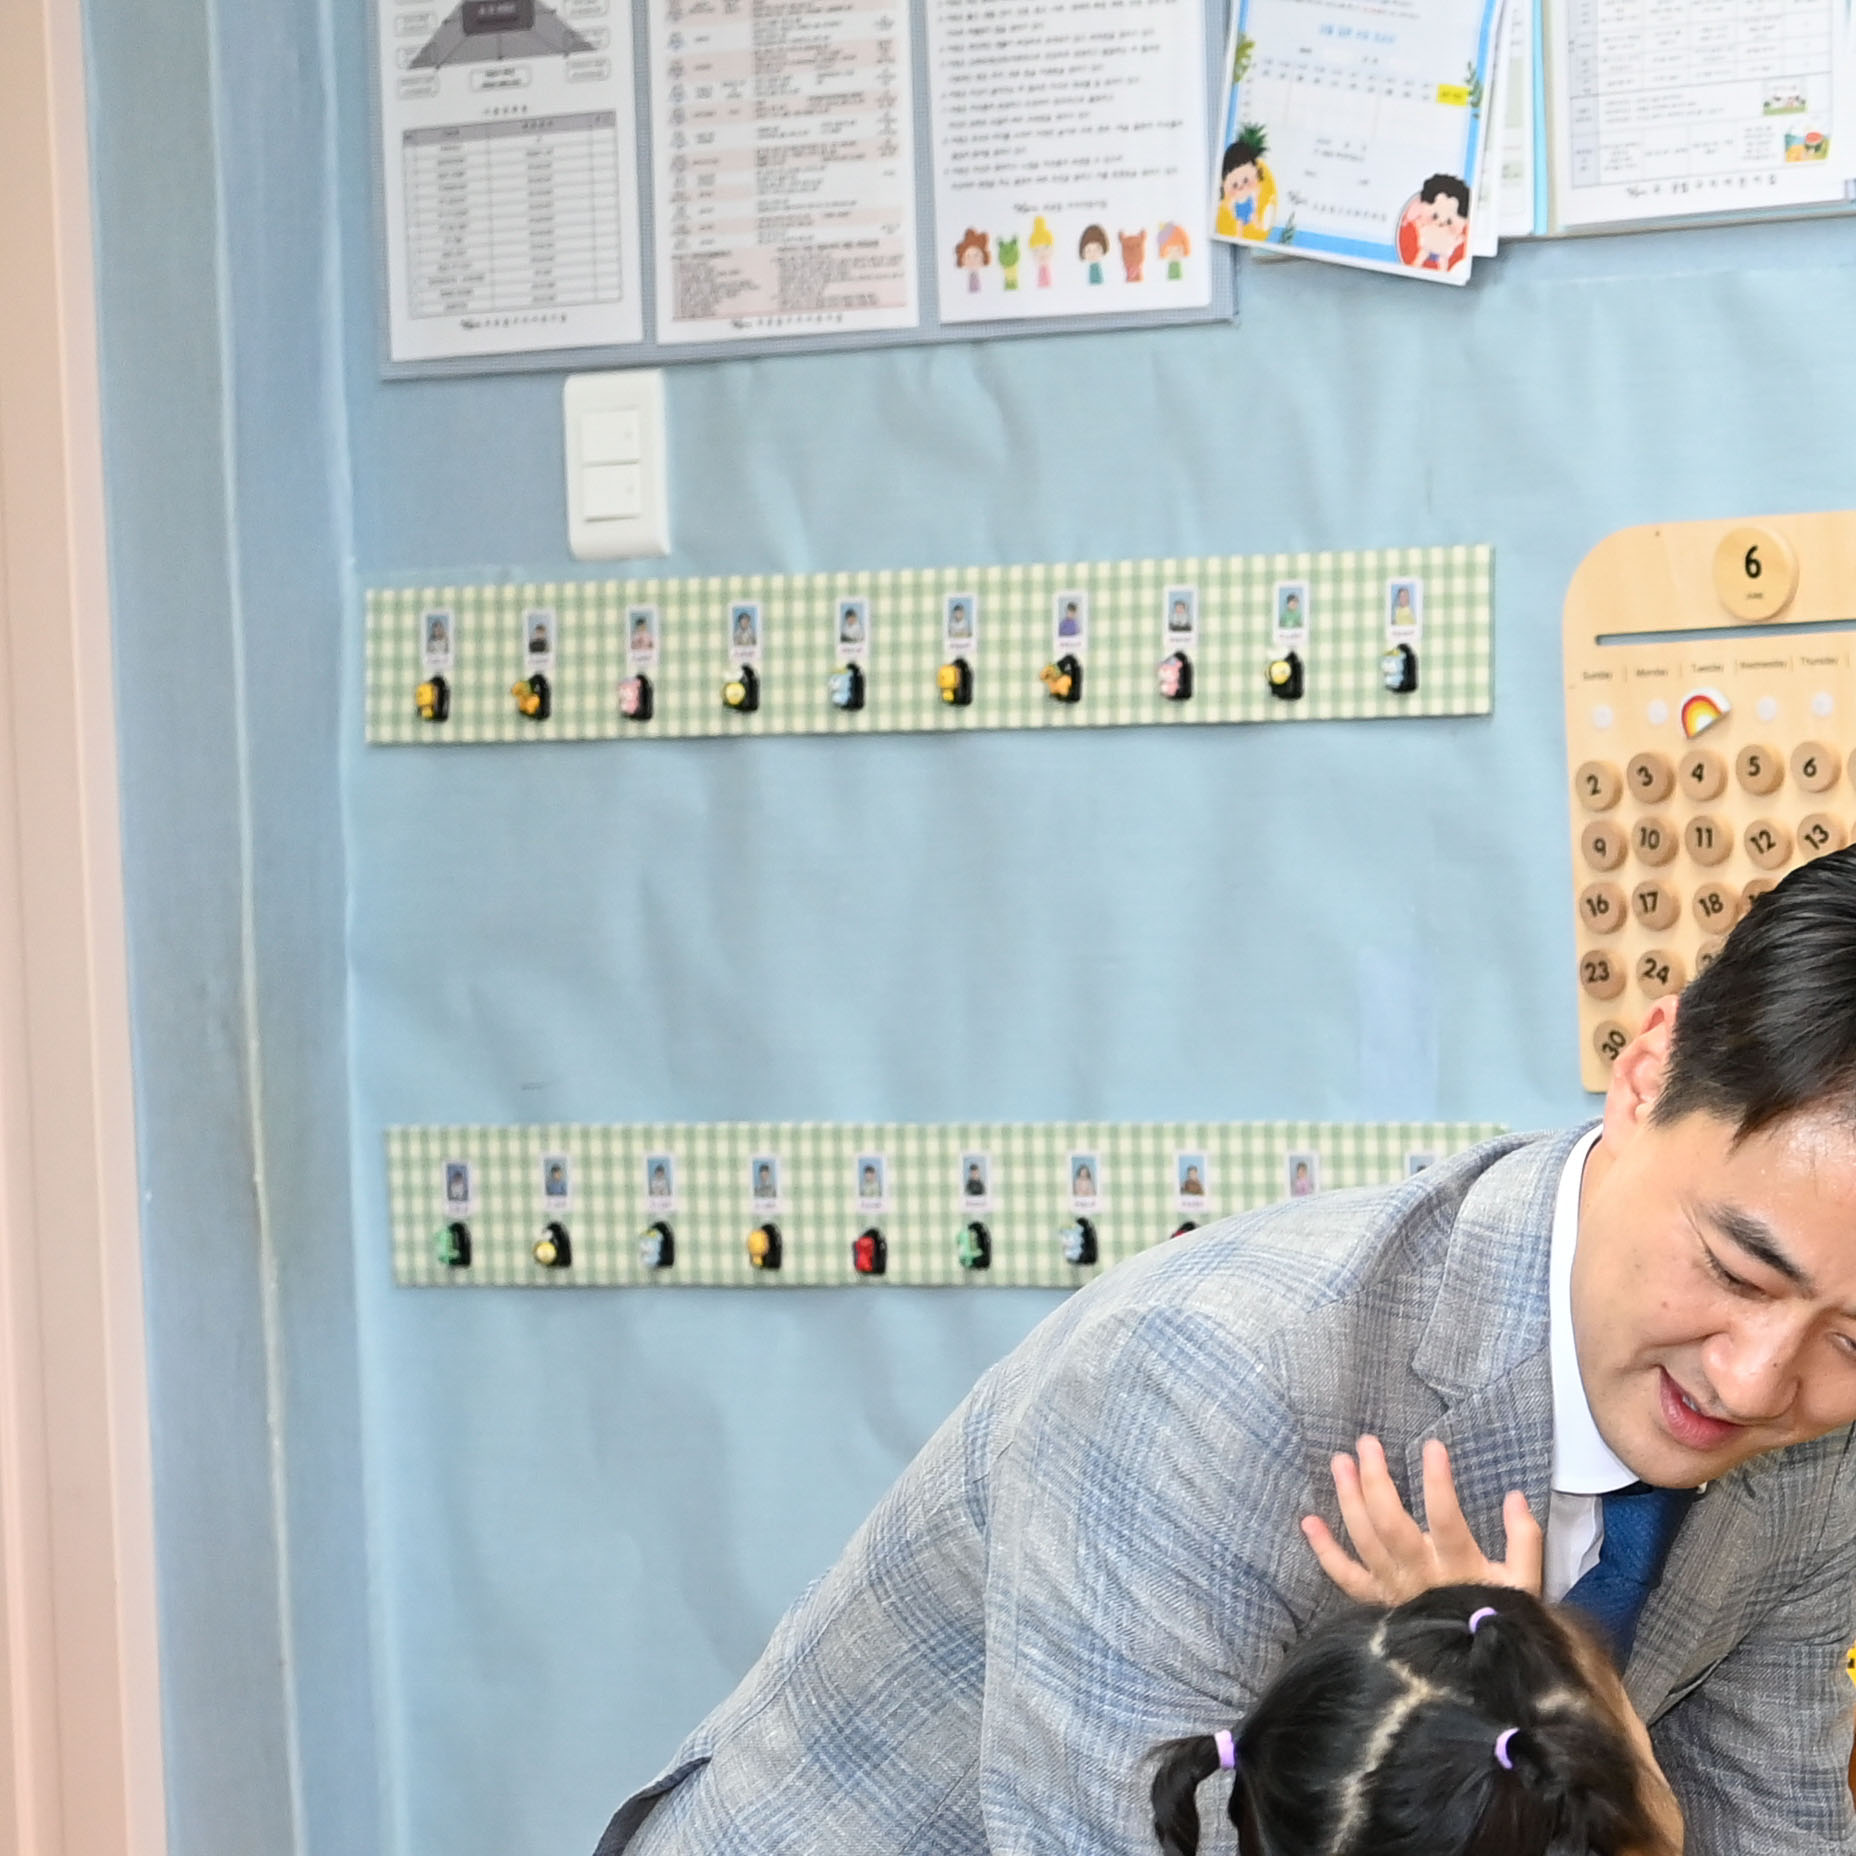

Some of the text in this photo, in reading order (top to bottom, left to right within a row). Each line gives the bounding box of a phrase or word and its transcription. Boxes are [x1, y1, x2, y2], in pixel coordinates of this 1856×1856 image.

[1745, 545, 1761, 579] 6
[1586, 774, 1601, 796] 2
[1637, 766, 1653, 787] 3
[1691, 763, 1705, 783] 4
[1748, 755, 1761, 777] 5
[1803, 757, 1817, 778] 6
[1593, 838, 1607, 857] 9
[1640, 826, 1660, 850] 10
[1695, 826, 1713, 849] 11
[1750, 829, 1776, 854] 12
[1804, 824, 1830, 850] 13
[1586, 894, 1610, 918] 16
[1639, 891, 1659, 914] 17
[1699, 893, 1724, 918] 18
[1584, 957, 1670, 985] 23 24
[1601, 1030, 1627, 1061] 30
